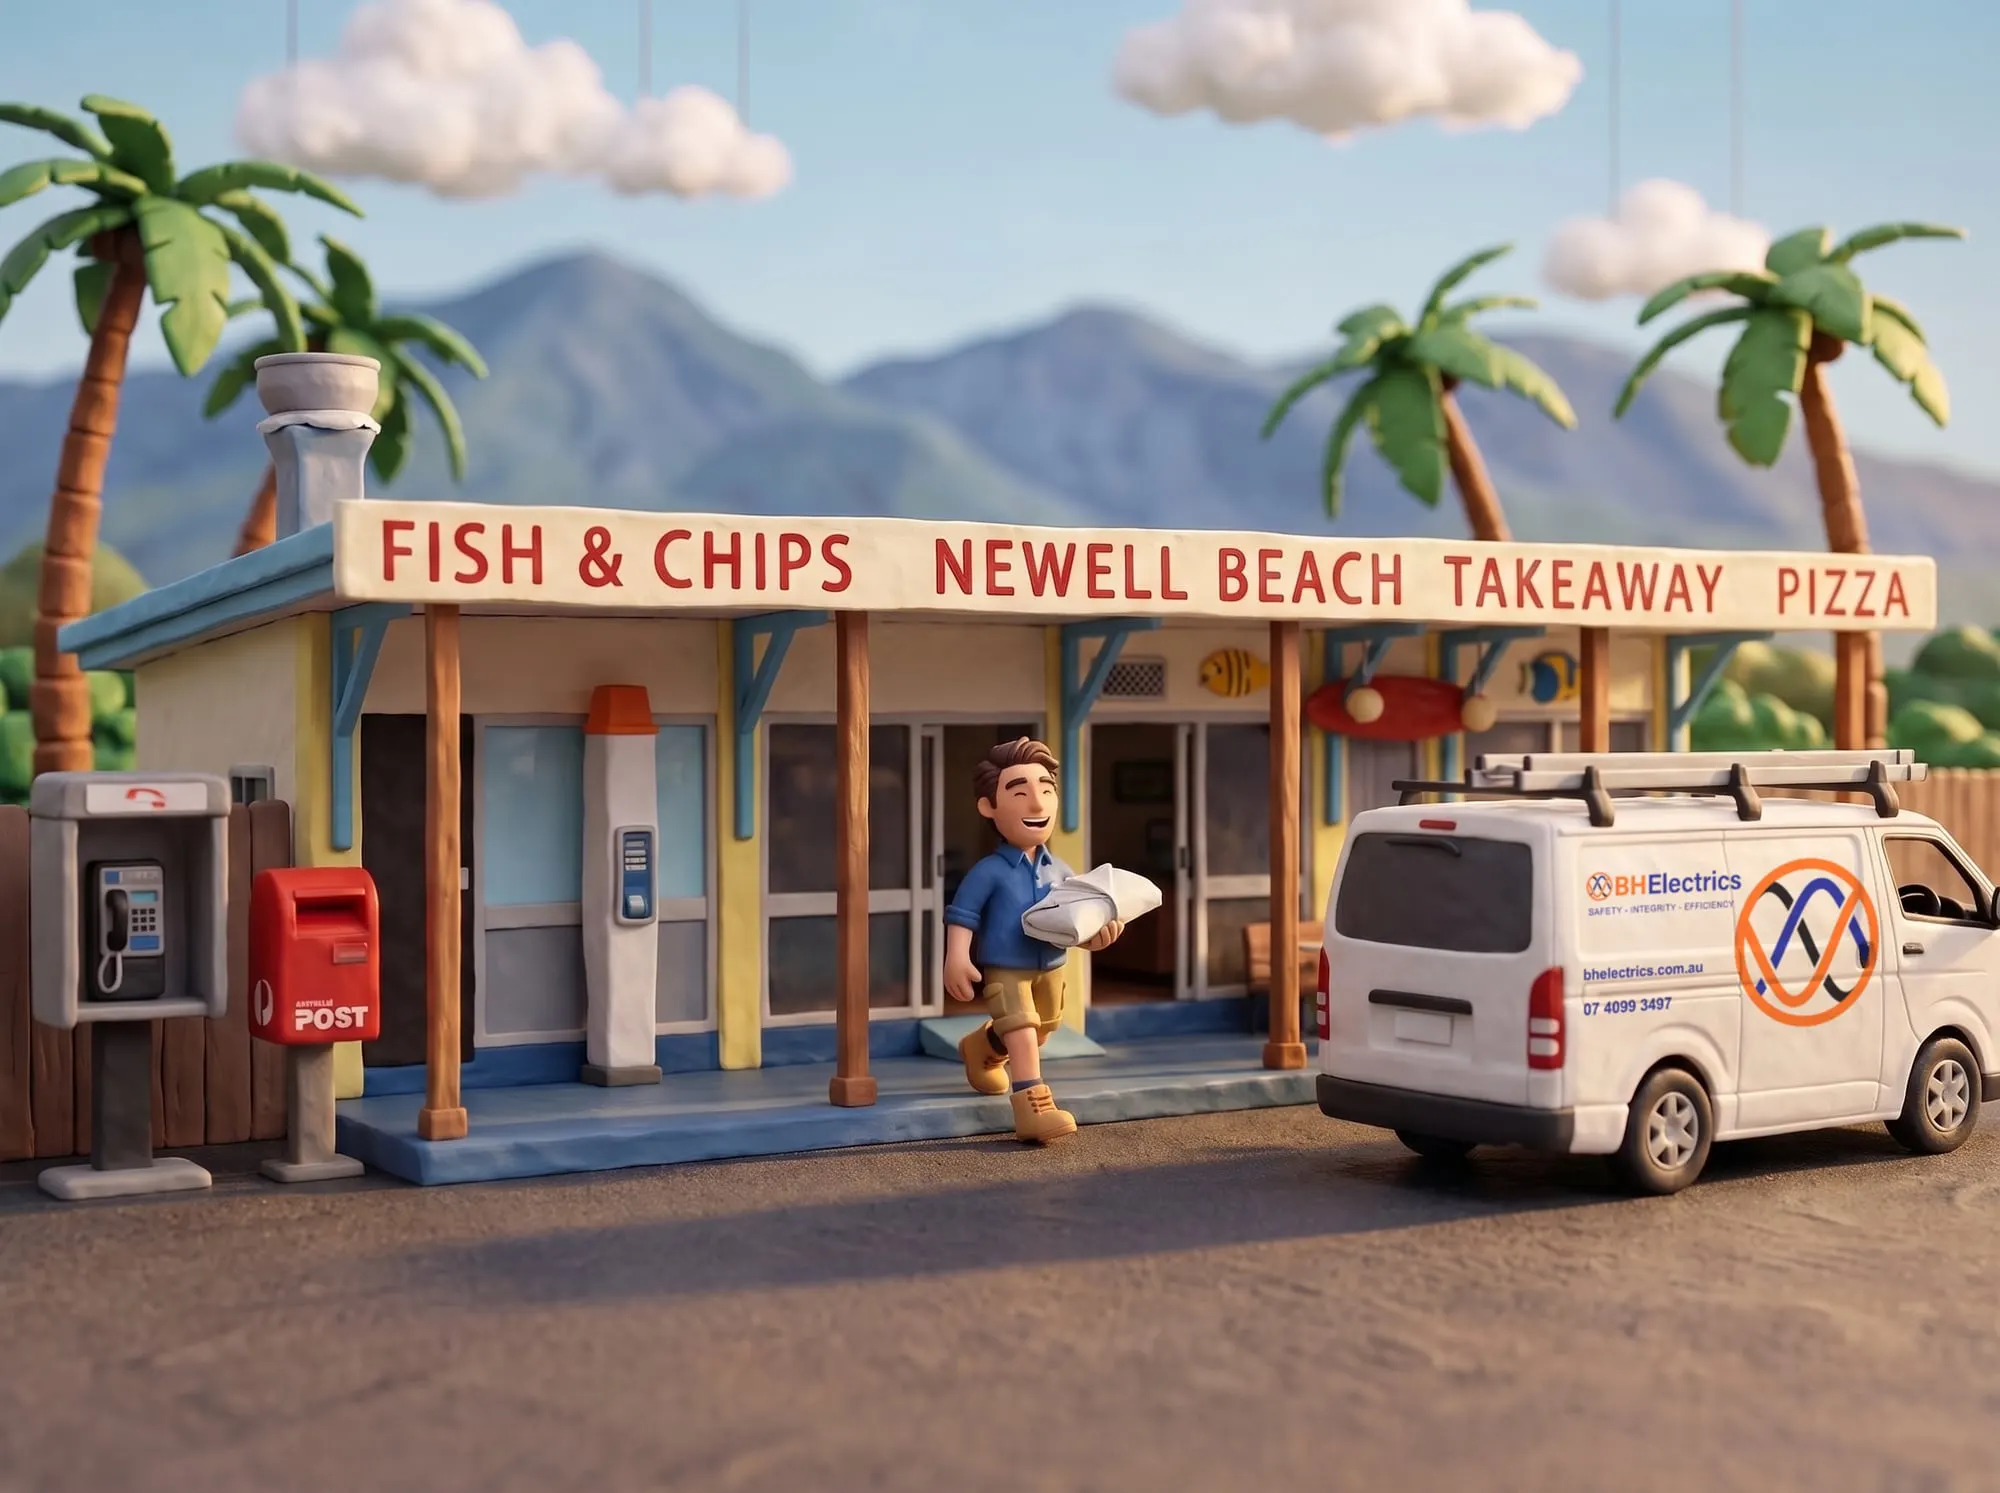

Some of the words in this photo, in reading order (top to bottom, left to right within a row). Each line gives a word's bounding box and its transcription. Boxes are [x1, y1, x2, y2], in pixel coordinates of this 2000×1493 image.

[382, 519, 544, 585] FISH
[578, 525, 623, 588] &
[653, 529, 853, 593] CHIPS
[935, 538, 1188, 601] NEWELL
[1218, 547, 1403, 606] BEACH
[1444, 555, 1723, 614] TAKEAWAY
[1777, 567, 1908, 617] PIZZA
[1588, 906, 1622, 916] SAFETY
[1630, 903, 1676, 914] INTEGRITY
[1684, 900, 1735, 911] EFFICIENCY
[1583, 963, 1704, 981] bhelectrics.com.au
[1583, 1002, 1600, 1016] 07
[1603, 999, 1636, 1014] 4099
[1640, 996, 1673, 1011] 3497
[295, 1005, 369, 1031] POST
